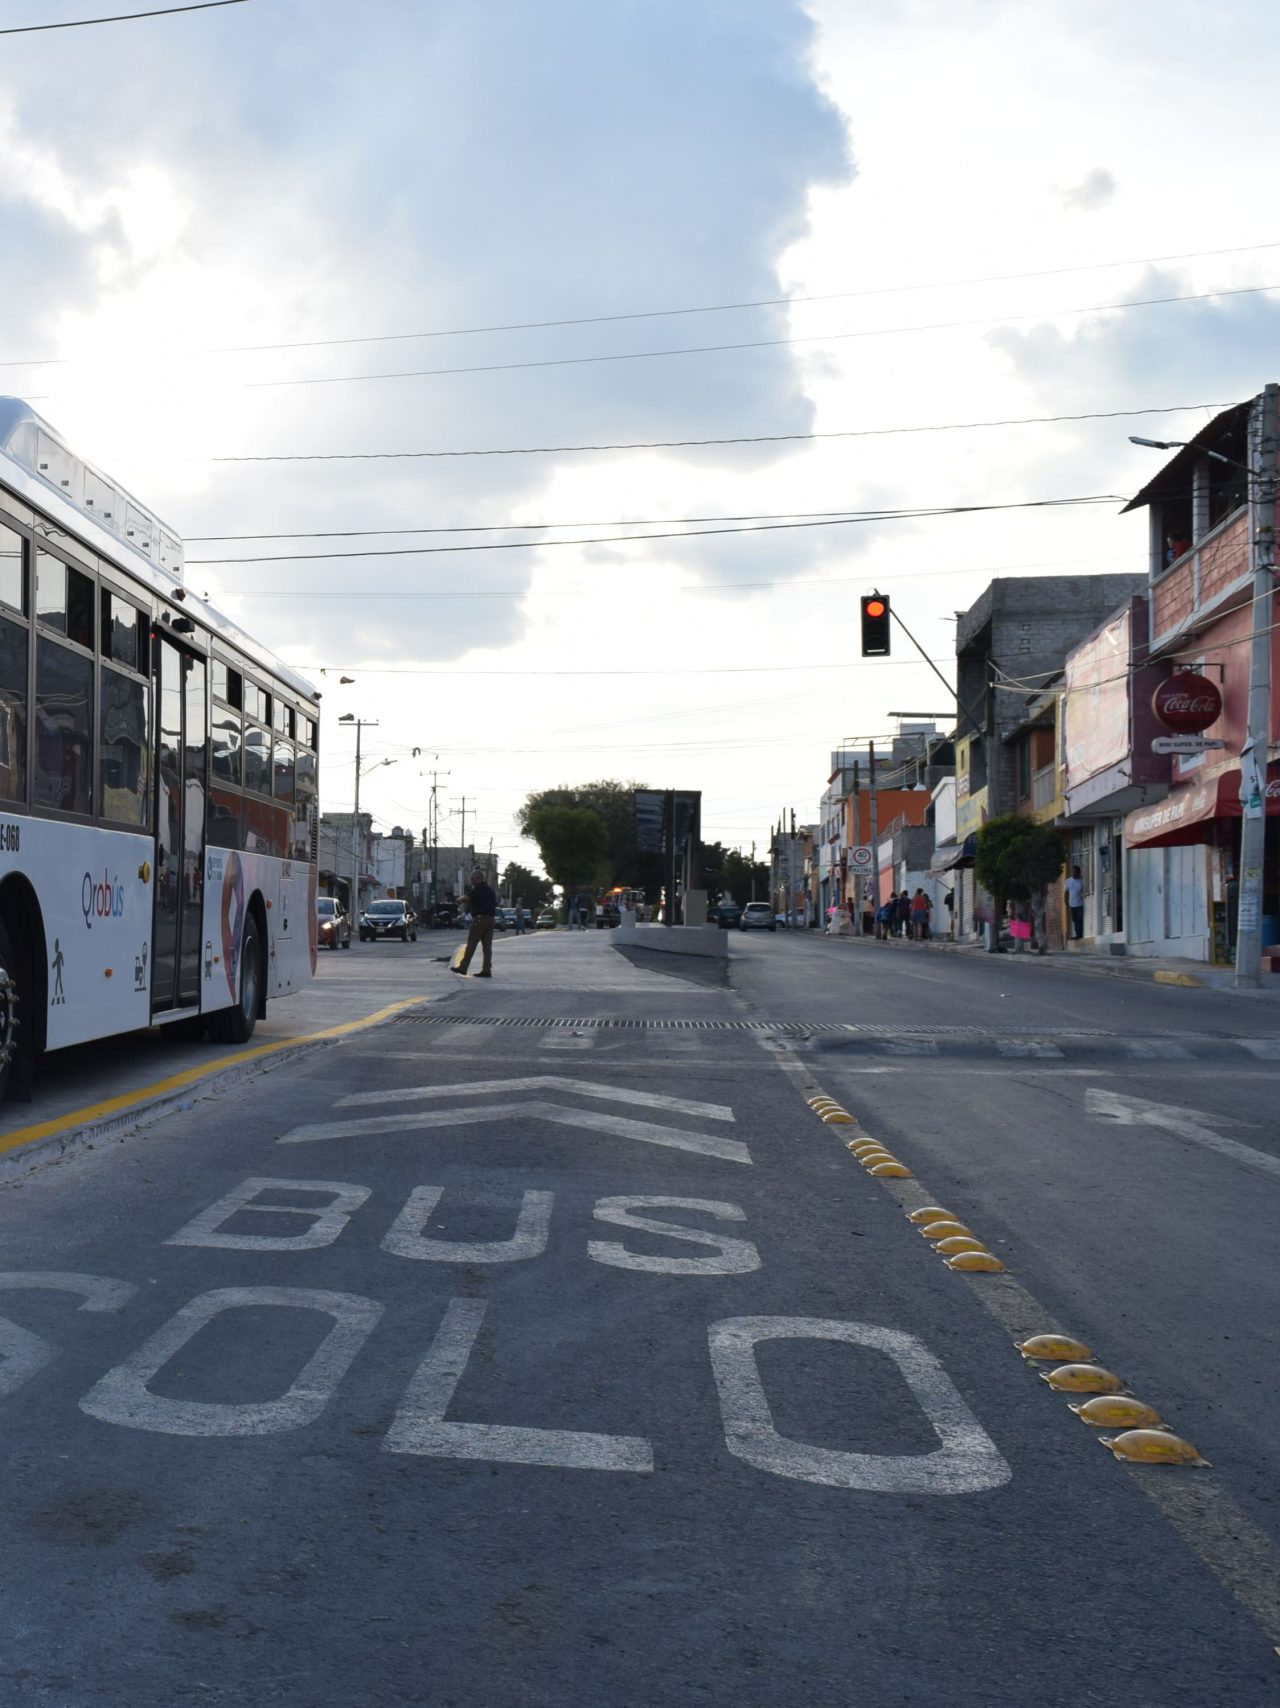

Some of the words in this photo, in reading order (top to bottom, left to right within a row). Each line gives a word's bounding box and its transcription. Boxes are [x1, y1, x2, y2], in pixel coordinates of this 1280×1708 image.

[0, 823, 20, 852] E-068
[81, 867, 124, 929] Qrobús
[162, 1177, 762, 1275] BUS
